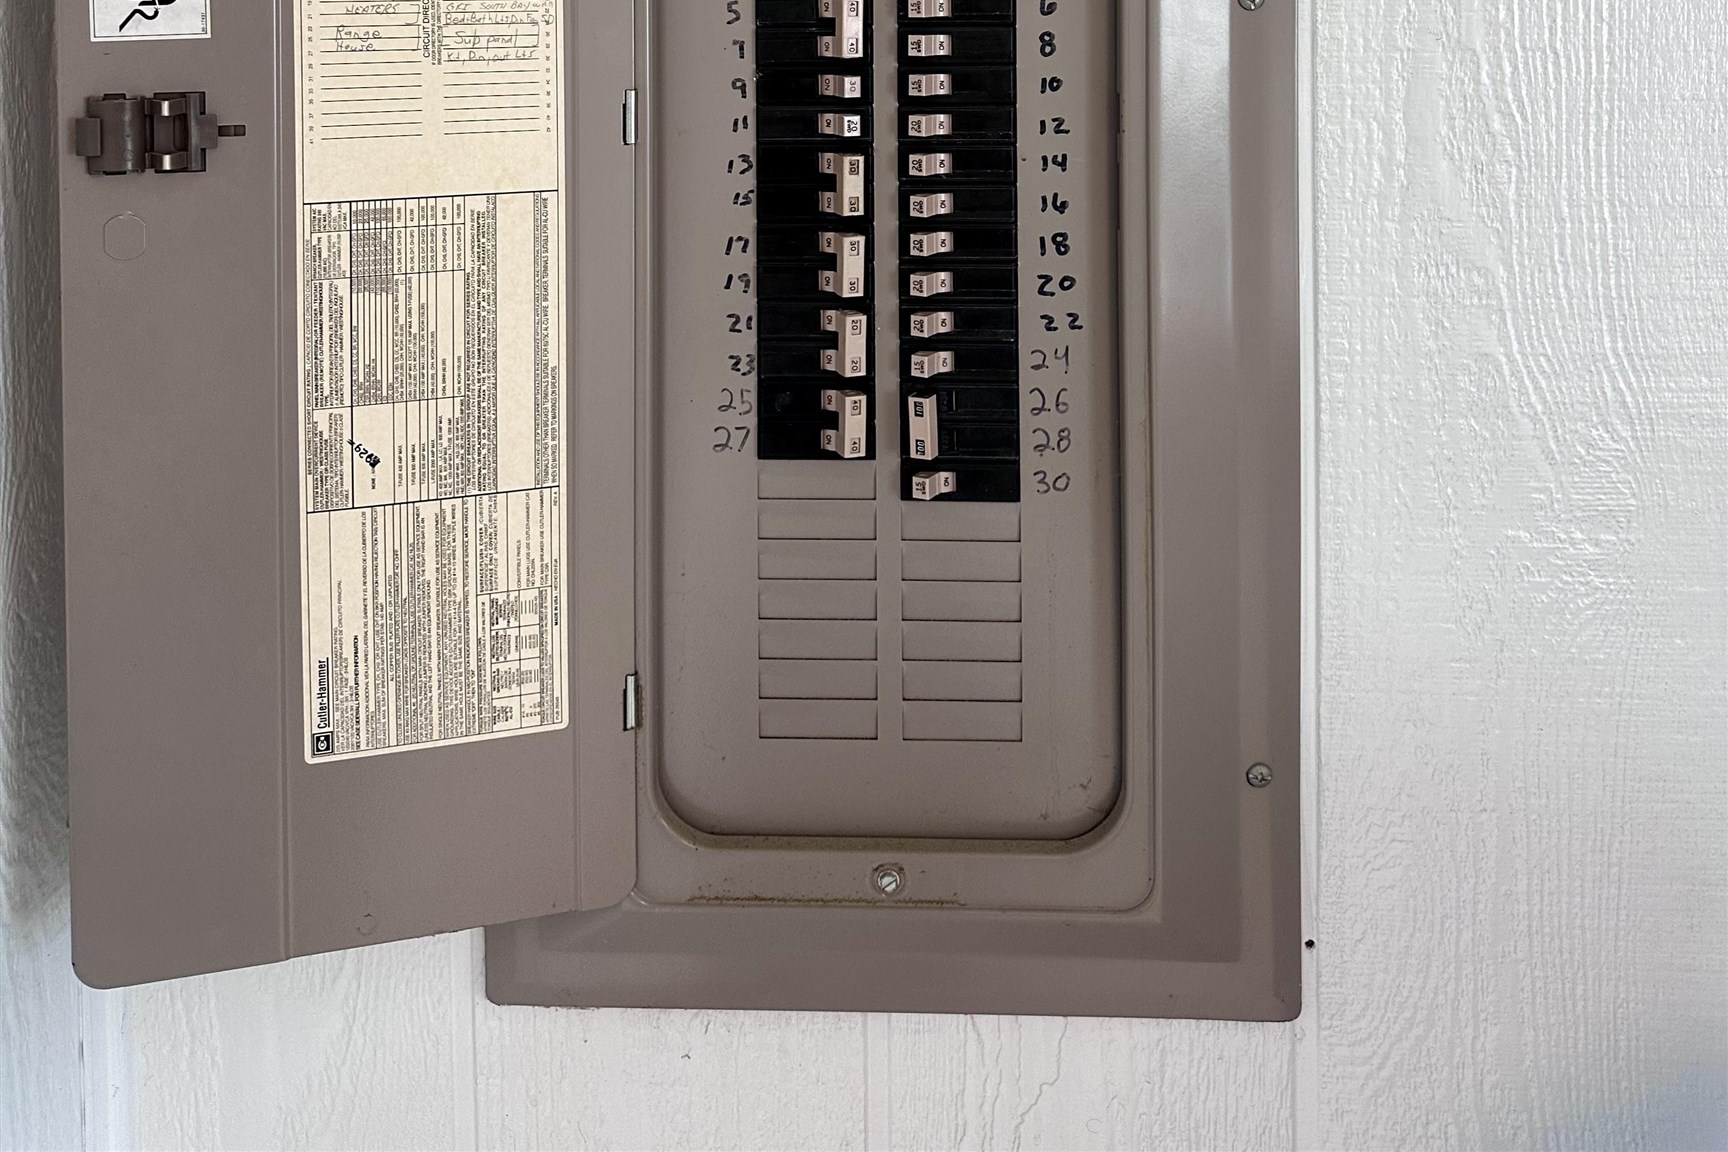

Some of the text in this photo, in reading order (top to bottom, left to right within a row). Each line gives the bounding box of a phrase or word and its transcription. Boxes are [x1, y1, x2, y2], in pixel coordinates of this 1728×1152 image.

[726, 0, 741, 24] 5
[824, 2, 830, 12] ON
[850, 2, 856, 12] 40
[939, 3, 945, 12] ON
[335, 24, 382, 42] Range
[454, 28, 481, 48] Sub
[335, 41, 375, 52] House
[422, 26, 430, 58] CIRCUIT
[825, 42, 831, 52] ON
[849, 42, 856, 52] 40
[939, 41, 945, 50] ON
[1038, 30, 1056, 57] 8
[731, 77, 747, 98] 9
[824, 78, 831, 91] ON
[850, 80, 857, 92] 30
[940, 80, 945, 90] ON
[1040, 76, 1063, 94] 10
[825, 119, 832, 127] ON
[852, 120, 858, 132] 20
[939, 121, 945, 130] ON
[1039, 116, 1070, 135] 12
[727, 154, 754, 175] 13
[826, 158, 832, 169] ON
[850, 161, 857, 172] 30
[939, 159, 946, 168] ON
[1040, 153, 1067, 172] 14
[732, 189, 755, 206] 15
[826, 197, 832, 208] ON
[850, 200, 857, 212] 30
[940, 200, 947, 208] ON
[1040, 192, 1069, 215] 16
[724, 236, 750, 256] 17
[826, 238, 832, 248] ON
[850, 241, 857, 251] 30
[940, 239, 947, 248] ON
[1039, 231, 1071, 256] 18
[723, 273, 751, 294] 19
[825, 276, 831, 286] ON
[850, 281, 856, 291] 30
[941, 279, 947, 288] ON
[1036, 274, 1077, 297] 20
[726, 313, 753, 334] 21
[827, 315, 833, 325] ON
[852, 320, 859, 330] 20
[941, 319, 947, 327] ON
[1039, 312, 1083, 332] 22
[728, 354, 756, 376] 23
[826, 355, 833, 365] ON
[942, 358, 948, 367] ON
[1030, 345, 1070, 374] 24
[852, 360, 859, 371] 20
[717, 388, 753, 415] 25
[827, 395, 833, 405] ON
[852, 400, 859, 411] 40
[1029, 387, 1070, 416] 26
[712, 426, 750, 453] 27
[826, 435, 832, 445] ON
[1032, 426, 1072, 455] 28
[852, 442, 858, 451] 40
[944, 477, 950, 487] ON
[1032, 470, 1071, 494] 30
[317, 659, 327, 728] Cutler-Hammer
